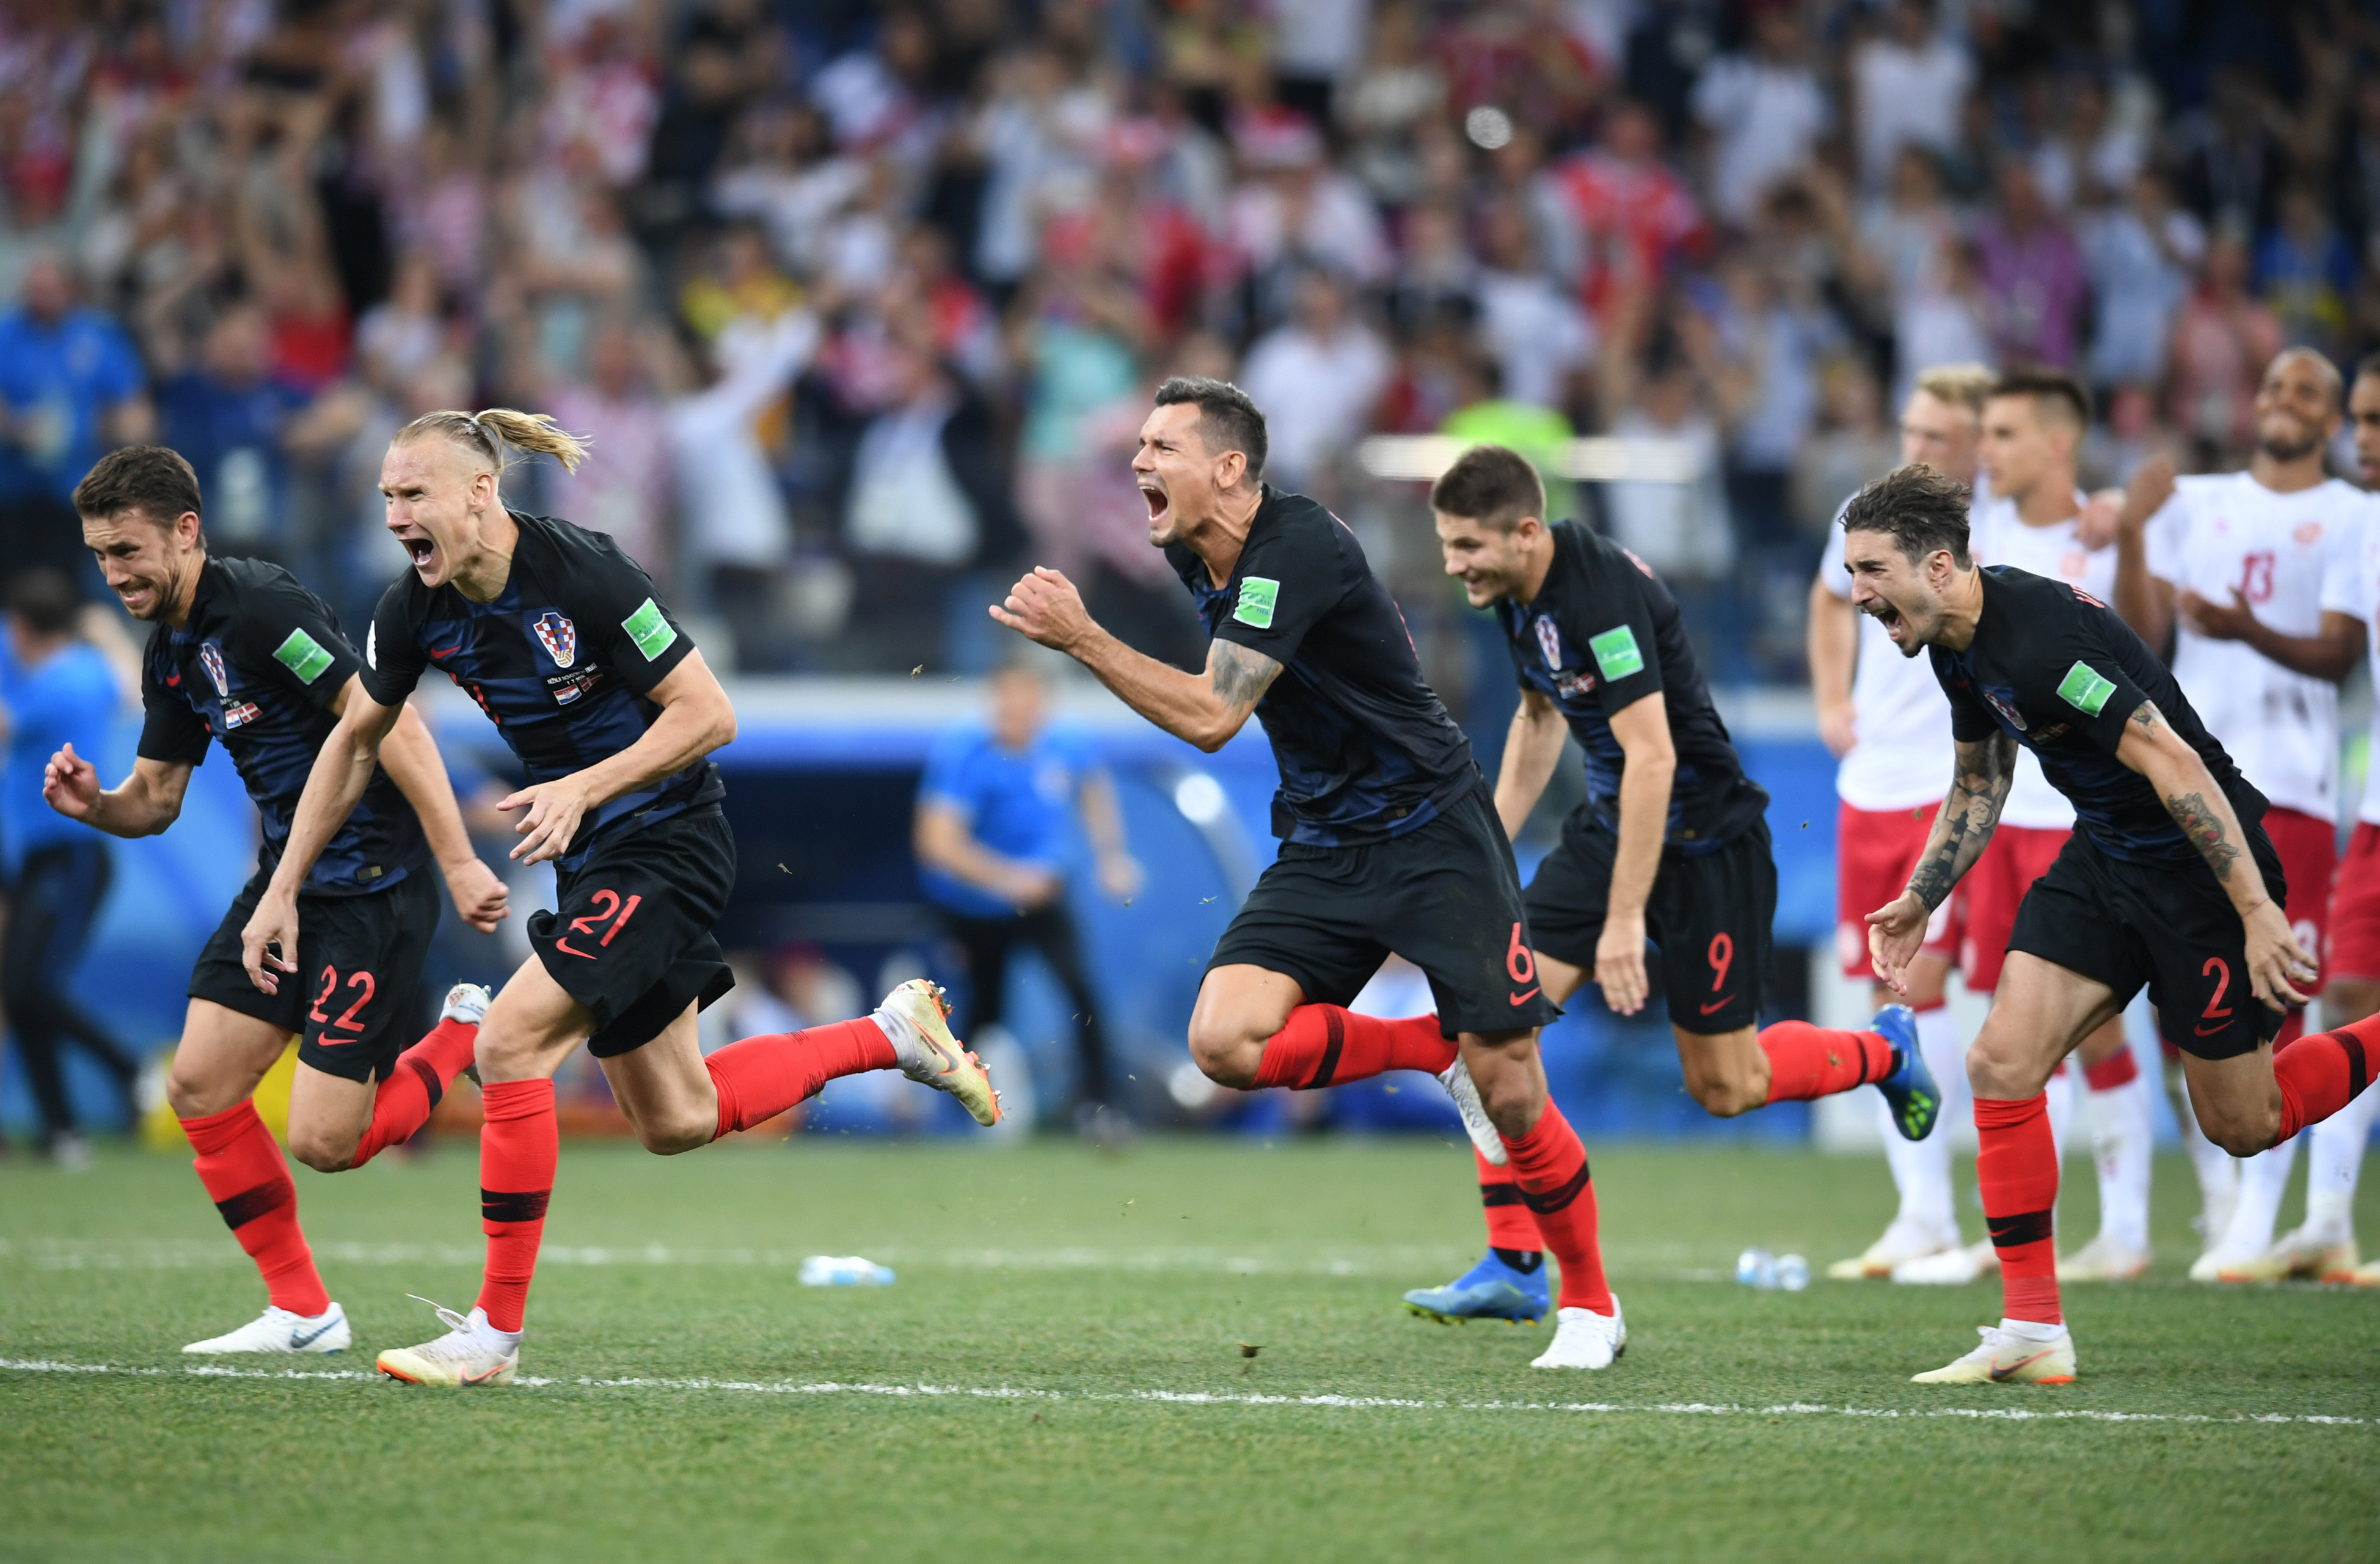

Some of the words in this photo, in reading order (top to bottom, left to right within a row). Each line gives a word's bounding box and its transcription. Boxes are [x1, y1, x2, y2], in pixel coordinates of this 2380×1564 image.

[2241, 551, 2275, 604] 13
[568, 889, 642, 947] 21
[1506, 922, 1535, 984] 6
[1707, 931, 1734, 993] 9
[309, 964, 376, 1032] 22
[2200, 957, 2233, 1018] 2
